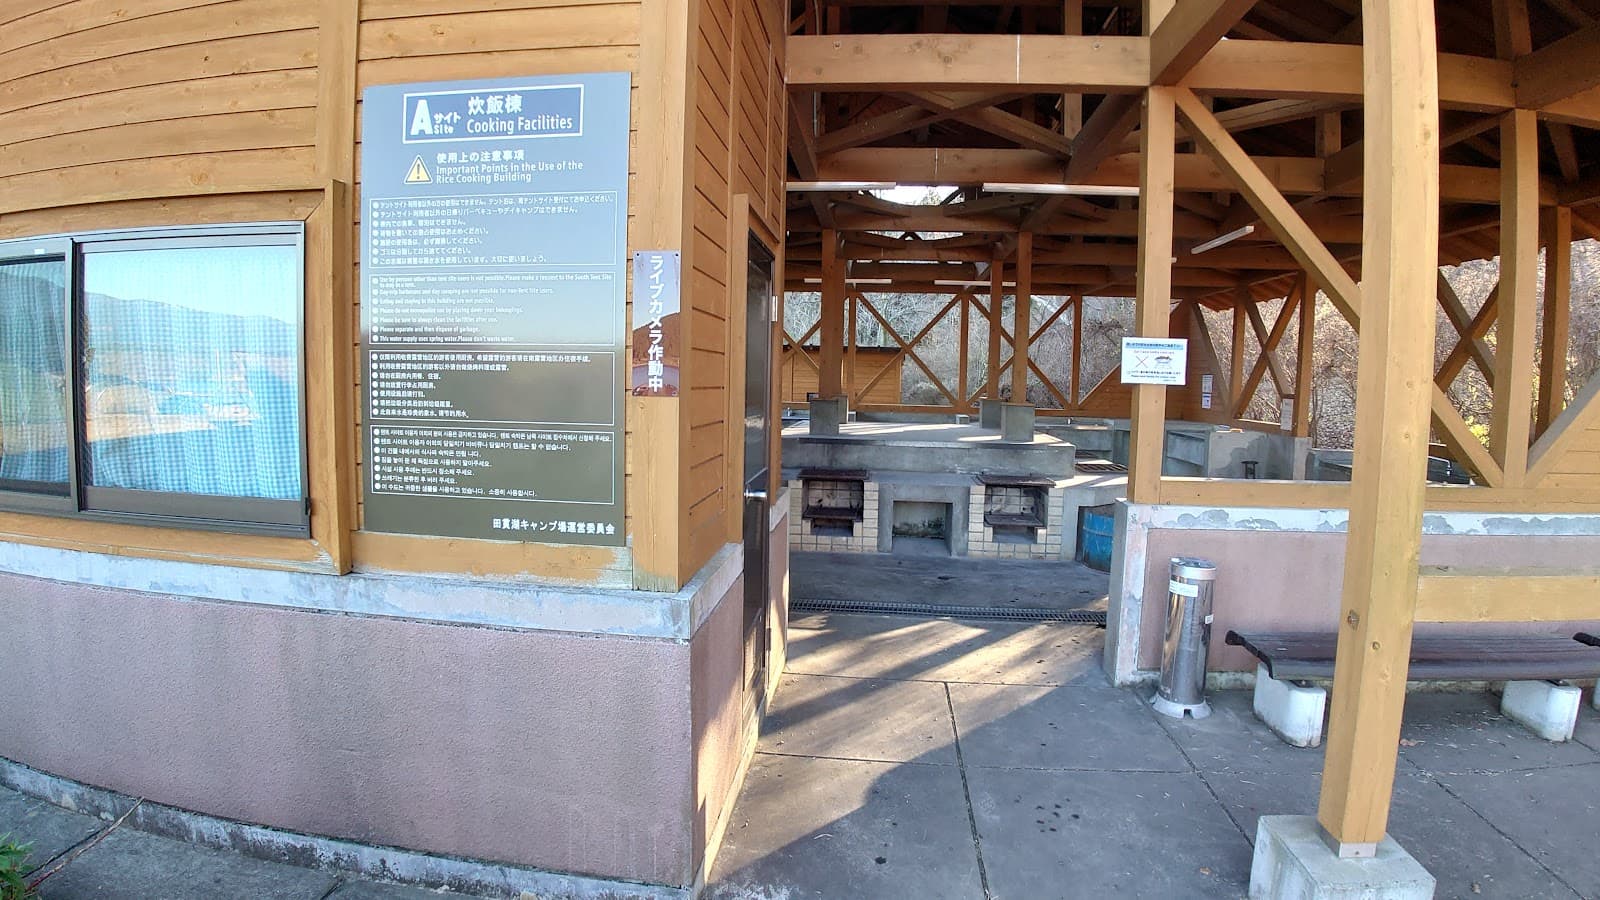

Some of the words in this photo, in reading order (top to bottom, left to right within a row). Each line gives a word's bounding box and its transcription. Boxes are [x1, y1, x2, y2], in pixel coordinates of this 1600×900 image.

[468, 94, 523, 116] 炊飯棟
[410, 99, 433, 136] A
[434, 111, 461, 124] サイト
[467, 118, 514, 135] Cooking
[518, 114, 573, 131] Facilities
[434, 124, 454, 135] Site
[437, 149, 525, 164] 使用上の注意事項
[437, 164, 480, 175] Important
[481, 163, 509, 173] Points
[511, 162, 520, 173] in
[521, 162, 536, 172] the
[538, 161, 554, 172] Use
[556, 161, 566, 171] of
[568, 160, 583, 170] the
[437, 174, 454, 184] Rice
[456, 173, 491, 185] Cooking
[493, 172, 531, 184] Building
[648, 255, 664, 392] ライブカメラ作動中
[492, 517, 615, 535] 田貫湖キャンプ場運営委員会
